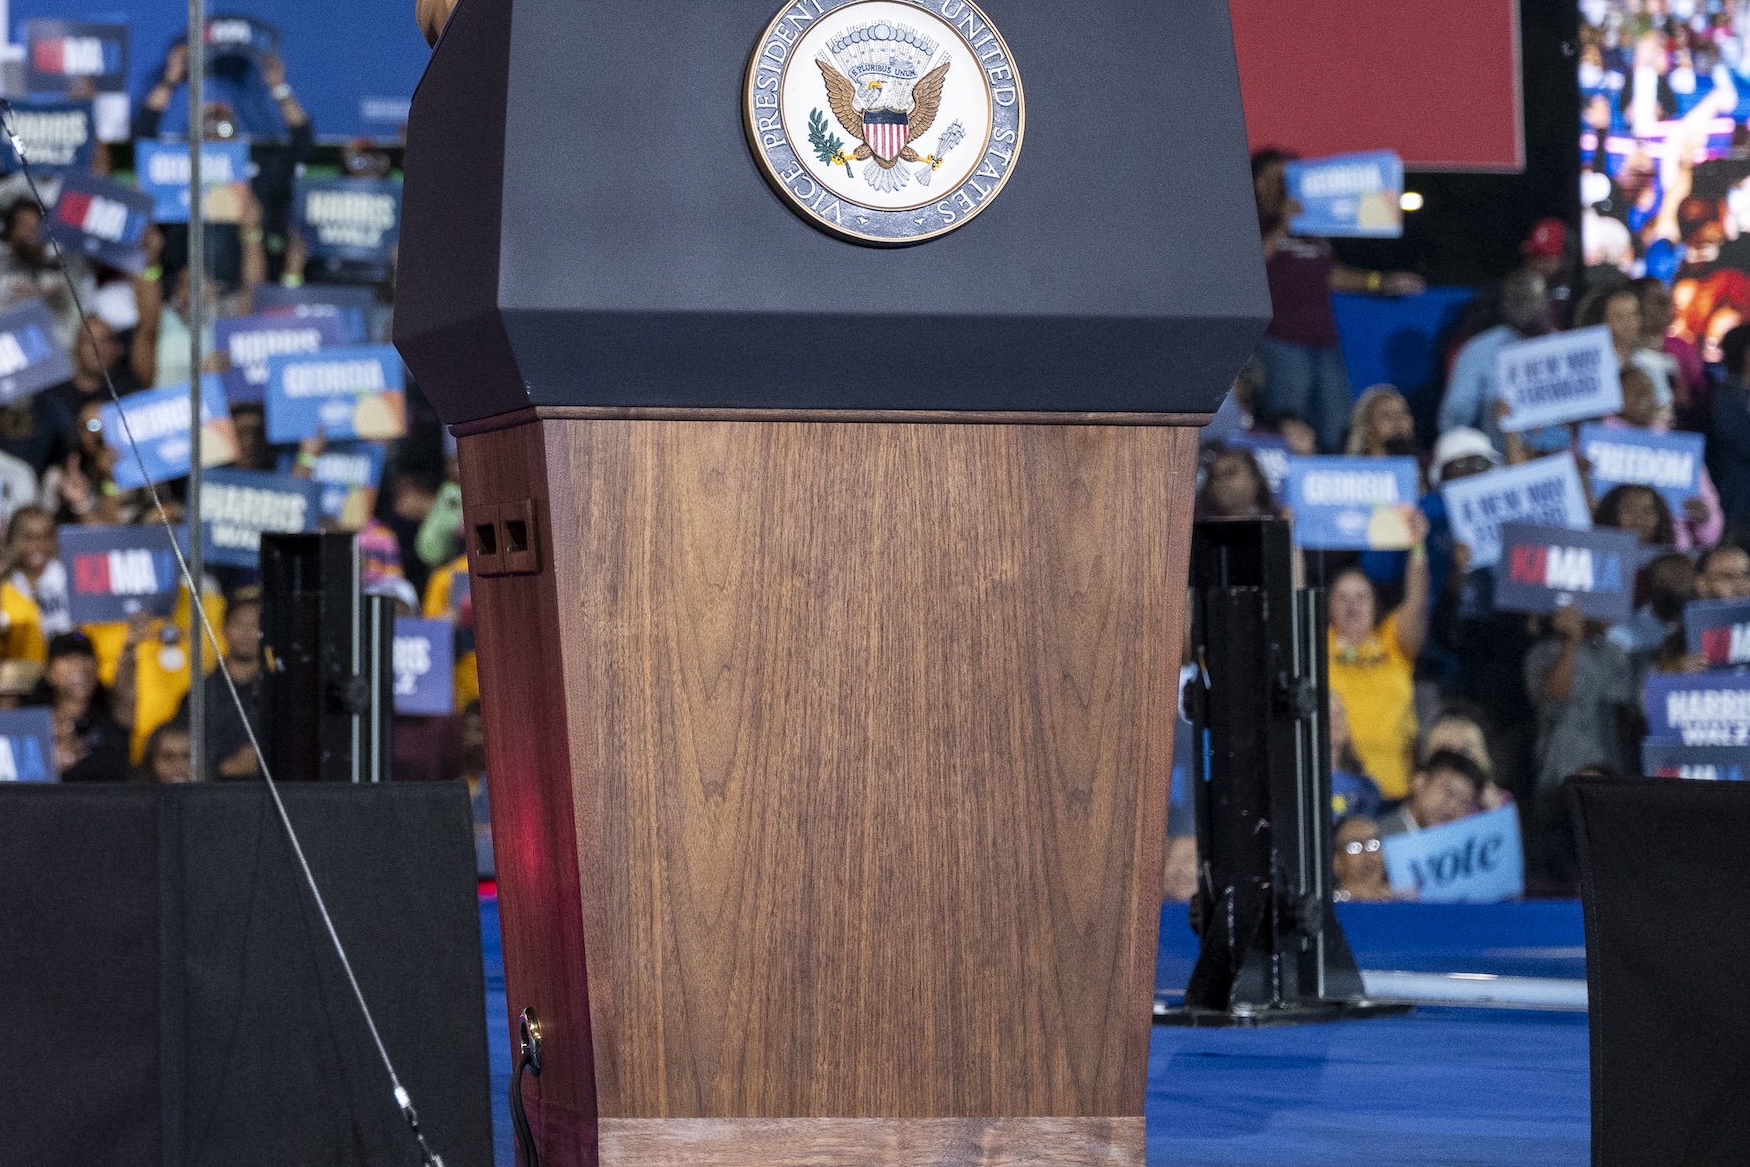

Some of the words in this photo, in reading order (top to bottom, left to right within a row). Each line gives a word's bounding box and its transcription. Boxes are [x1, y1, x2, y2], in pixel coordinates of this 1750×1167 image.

[857, 64, 892, 74] PLURIBUS
[894, 68, 917, 77] UNUM
[780, 161, 842, 224] VICE
[936, 126, 1016, 224] STATES
[1302, 472, 1400, 506] GEORGIA
[1666, 689, 1750, 729] HARRI
[1404, 834, 1505, 889] vote
